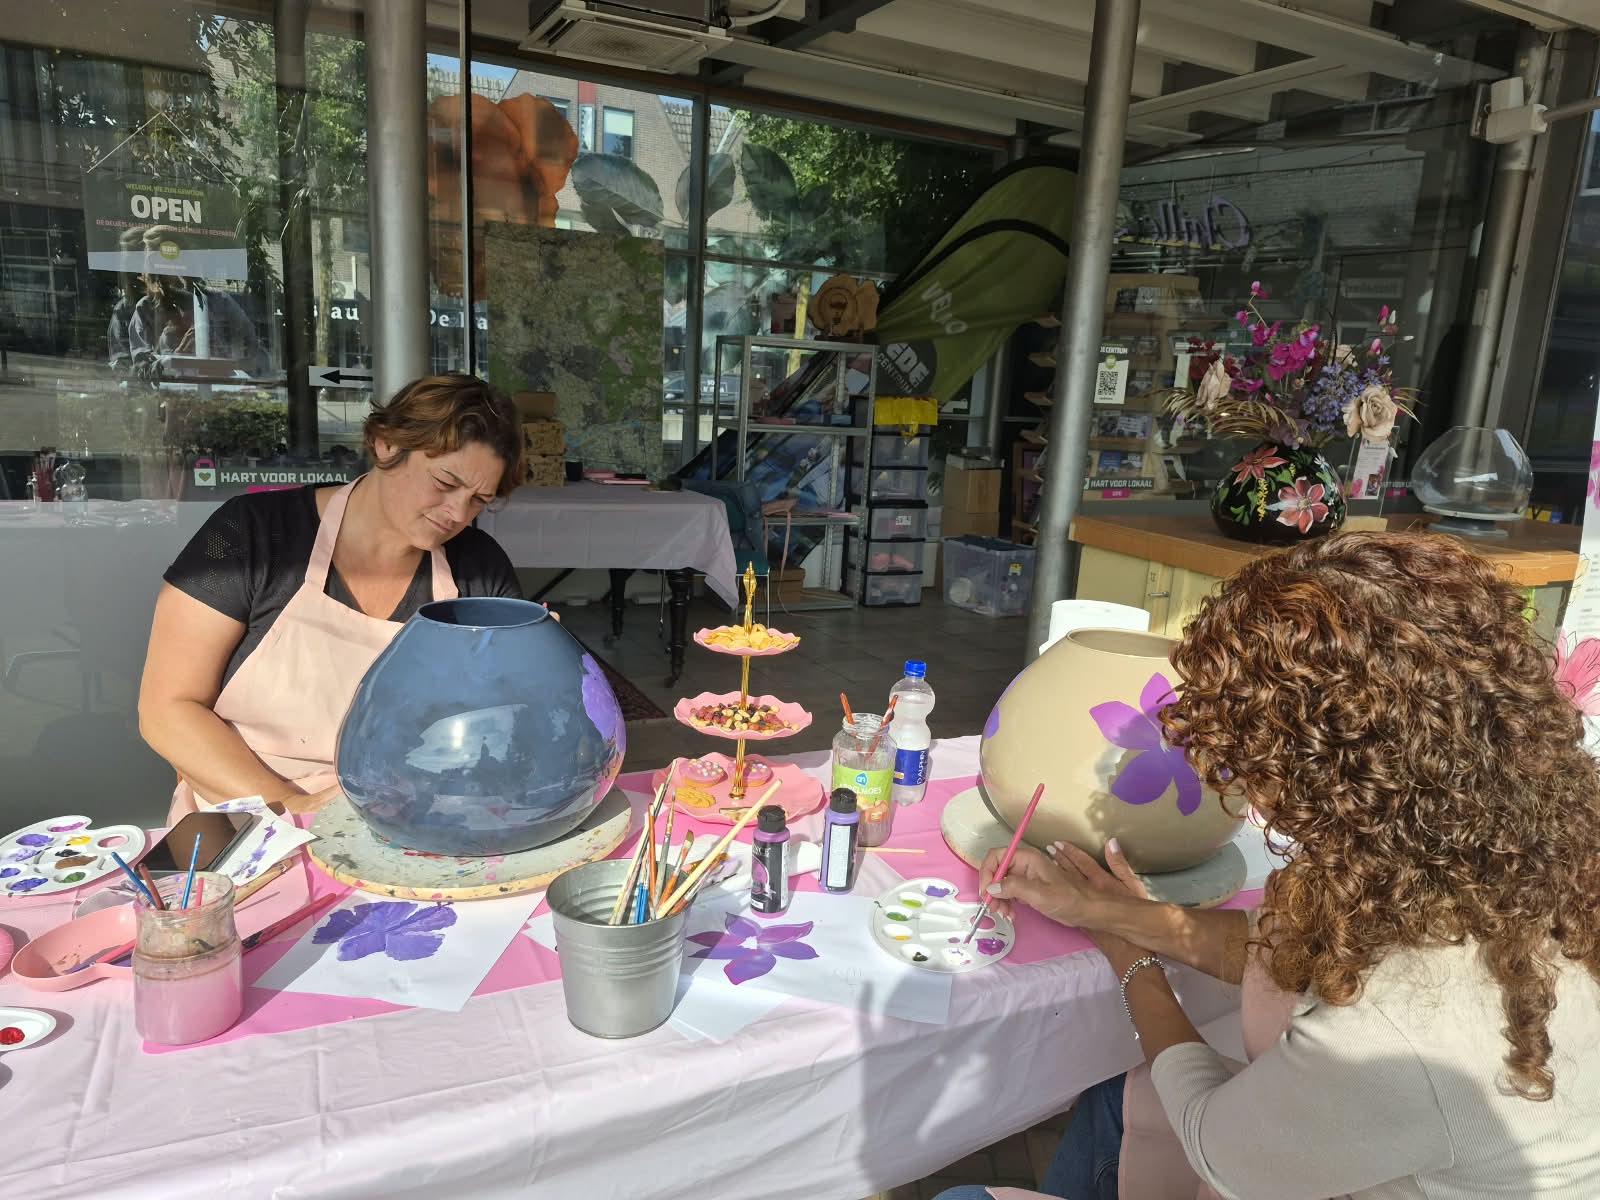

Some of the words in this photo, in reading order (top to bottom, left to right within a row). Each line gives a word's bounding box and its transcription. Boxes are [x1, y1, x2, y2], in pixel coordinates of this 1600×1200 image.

[131, 195, 201, 224] OPEN
[878, 352, 913, 395] CENTRUM
[886, 343, 930, 388] EDE
[220, 472, 257, 483] HART
[260, 472, 297, 483] VOOR
[300, 473, 350, 484] LOKAAL
[1091, 480, 1109, 488] HART
[1109, 480, 1127, 488] VOOR
[1128, 480, 1153, 488] LOKAAL
